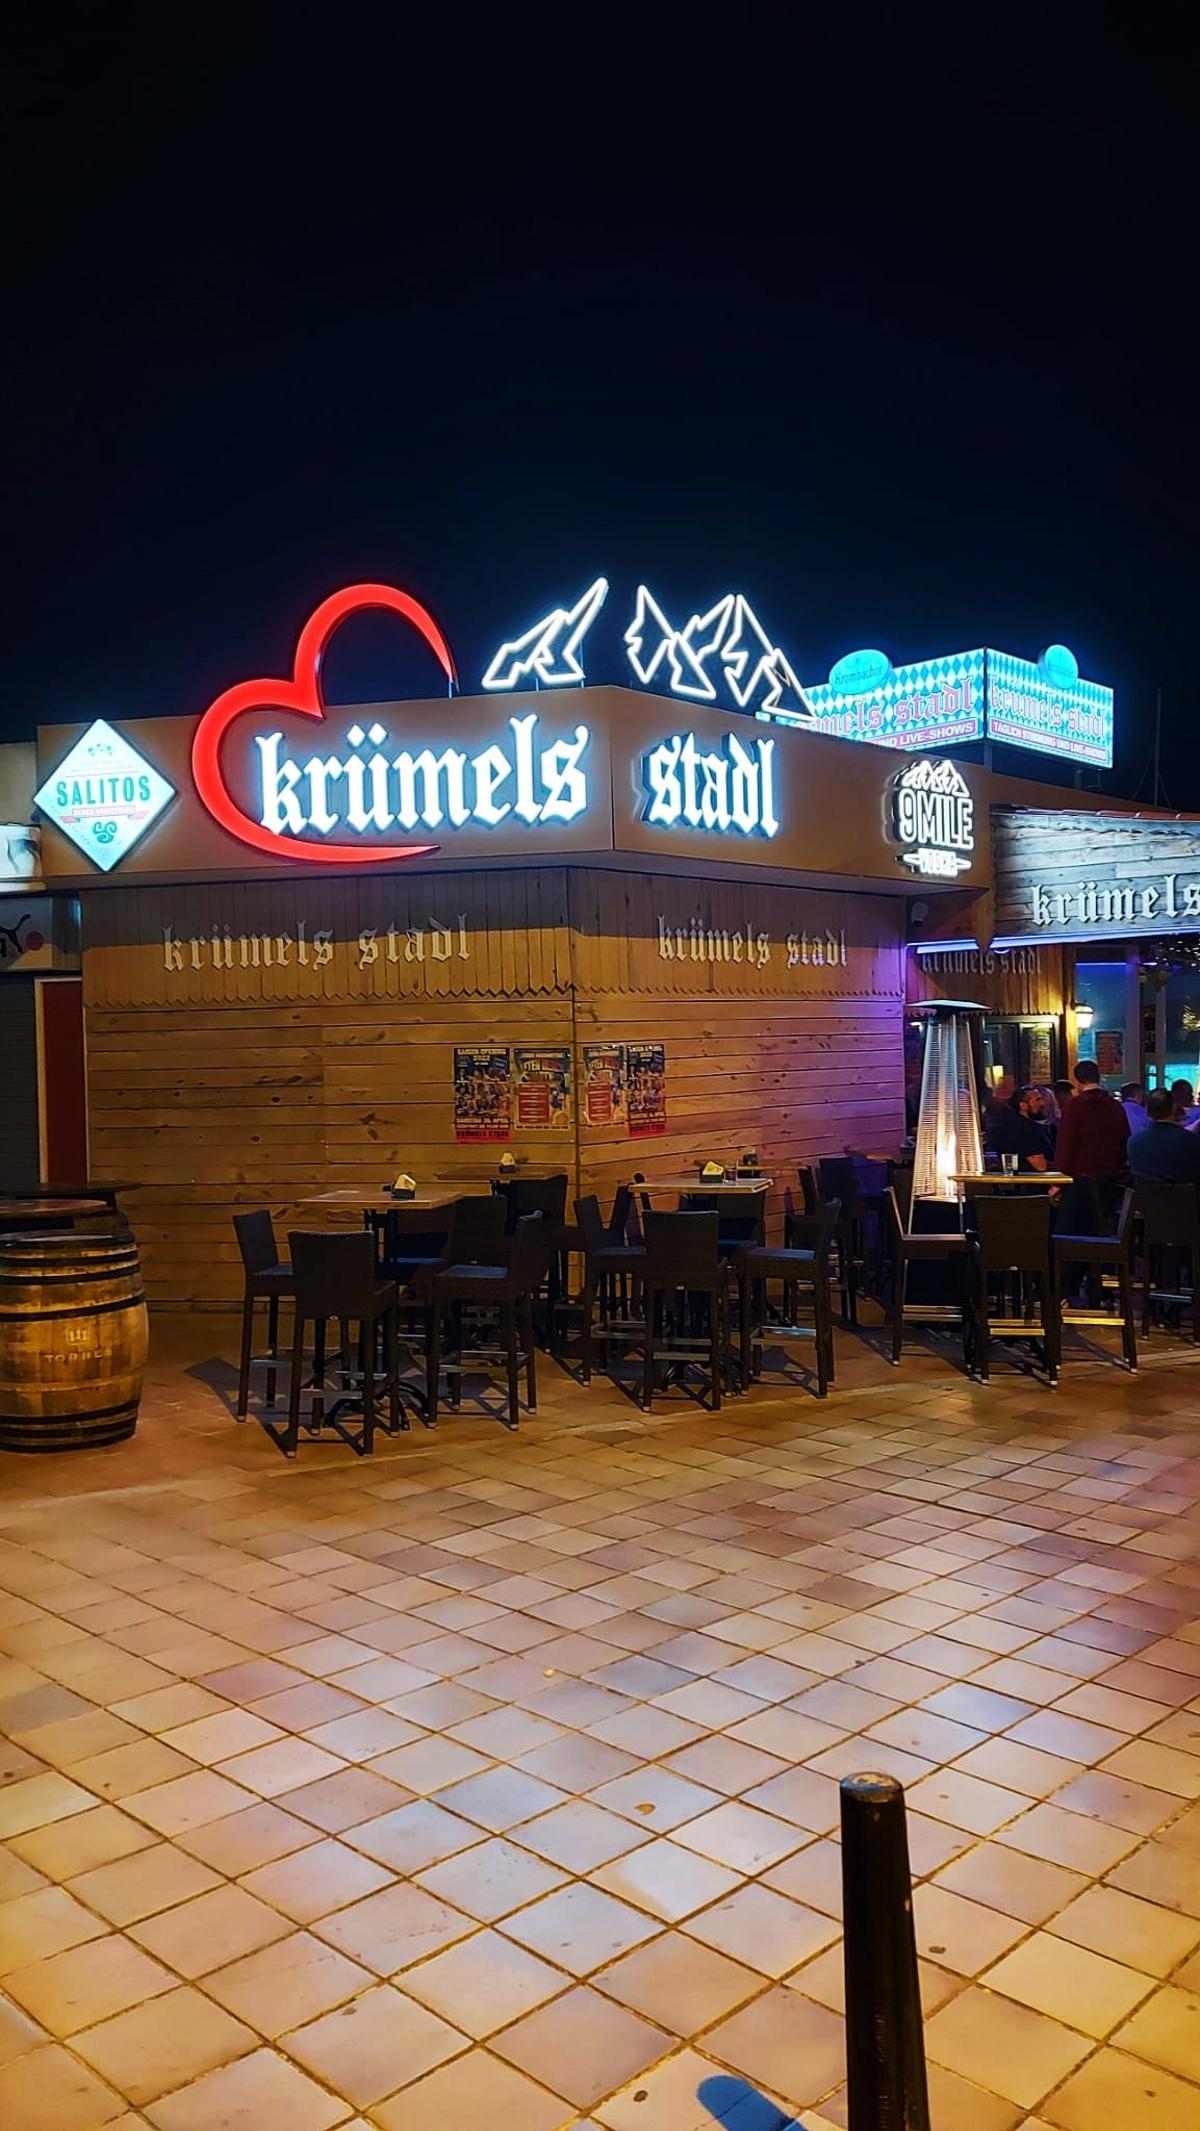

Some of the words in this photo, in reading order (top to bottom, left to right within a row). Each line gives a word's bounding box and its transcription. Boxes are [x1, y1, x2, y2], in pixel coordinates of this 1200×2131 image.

[893, 675, 974, 727] stadl
[900, 721, 974, 746] LIVE-SHOWS
[56, 775, 151, 807] SALITOS
[254, 713, 590, 835] krümels
[648, 731, 780, 838] stadl
[898, 787, 974, 851] 9MILE
[1031, 873, 1200, 926] krümels
[163, 920, 334, 971] krümels
[358, 912, 471, 970] stadl
[657, 914, 771, 970] krümels
[786, 928, 847, 969] stadl
